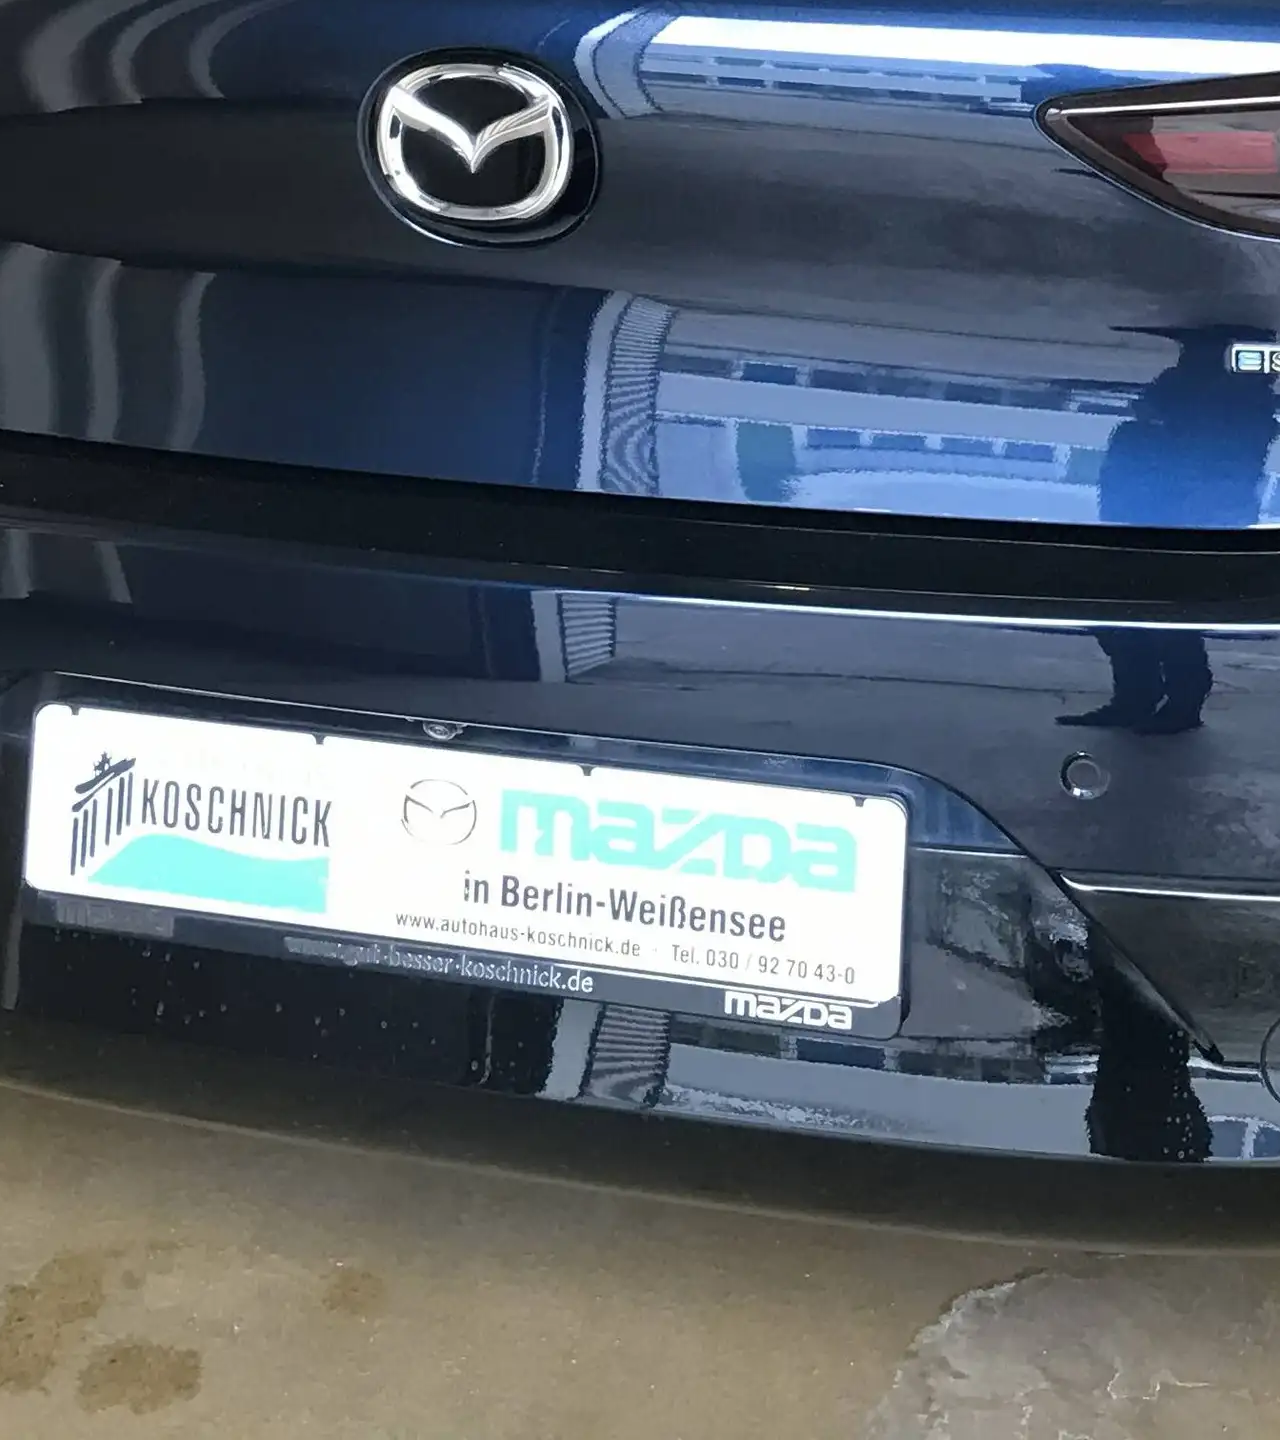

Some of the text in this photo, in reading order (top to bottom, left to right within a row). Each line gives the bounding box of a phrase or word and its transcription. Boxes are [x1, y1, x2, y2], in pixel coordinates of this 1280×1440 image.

[140, 777, 333, 848] KOSCHNICK
[499, 787, 858, 893] mazda
[463, 869, 786, 942] in Berlin-Weißensee
[395, 912, 641, 958] www.autohaus-koschnick.de
[672, 943, 699, 965] Tel.
[706, 948, 739, 970] 030
[758, 954, 779, 975] 92
[787, 958, 807, 978] 70
[813, 963, 856, 985] 43-0
[723, 989, 853, 1031] mazda
